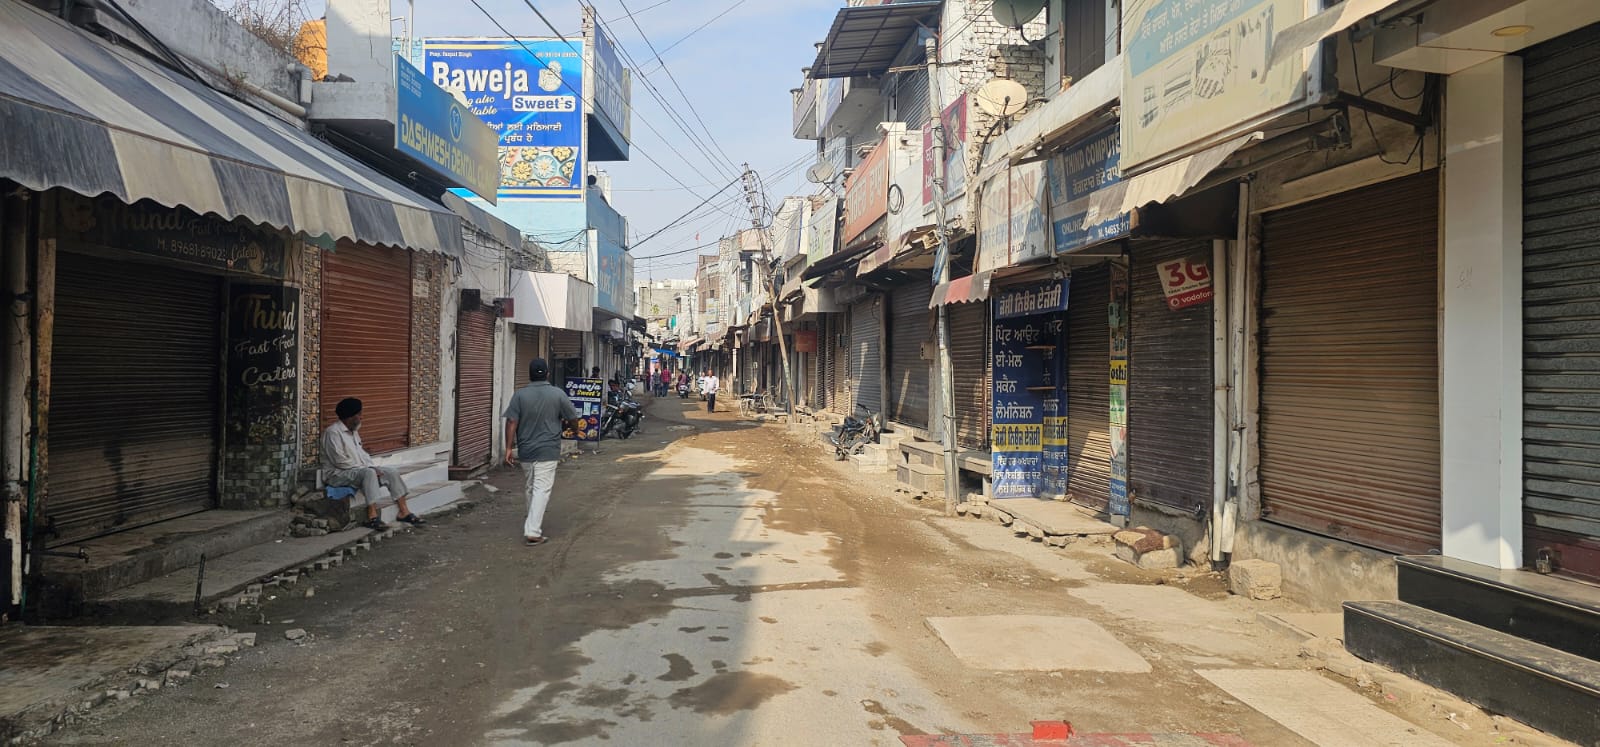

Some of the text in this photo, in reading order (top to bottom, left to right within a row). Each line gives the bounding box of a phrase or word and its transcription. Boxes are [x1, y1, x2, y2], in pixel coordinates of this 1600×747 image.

[432, 61, 529, 100] Baweja
[475, 95, 495, 105] also
[514, 97, 573, 109] Sweet's
[402, 113, 450, 170] DASHMESH
[451, 146, 479, 188] DENTAL
[1064, 131, 1121, 178] THIND COMPUTE
[1164, 262, 1209, 288] 3G
[236, 294, 296, 333] Thind
[234, 334, 295, 359] Fast Food
[284, 352, 291, 366] &
[995, 374, 1018, 393] ਸਕੈਨ
[1110, 364, 1127, 381] oshi
[566, 380, 602, 392] Baweja
